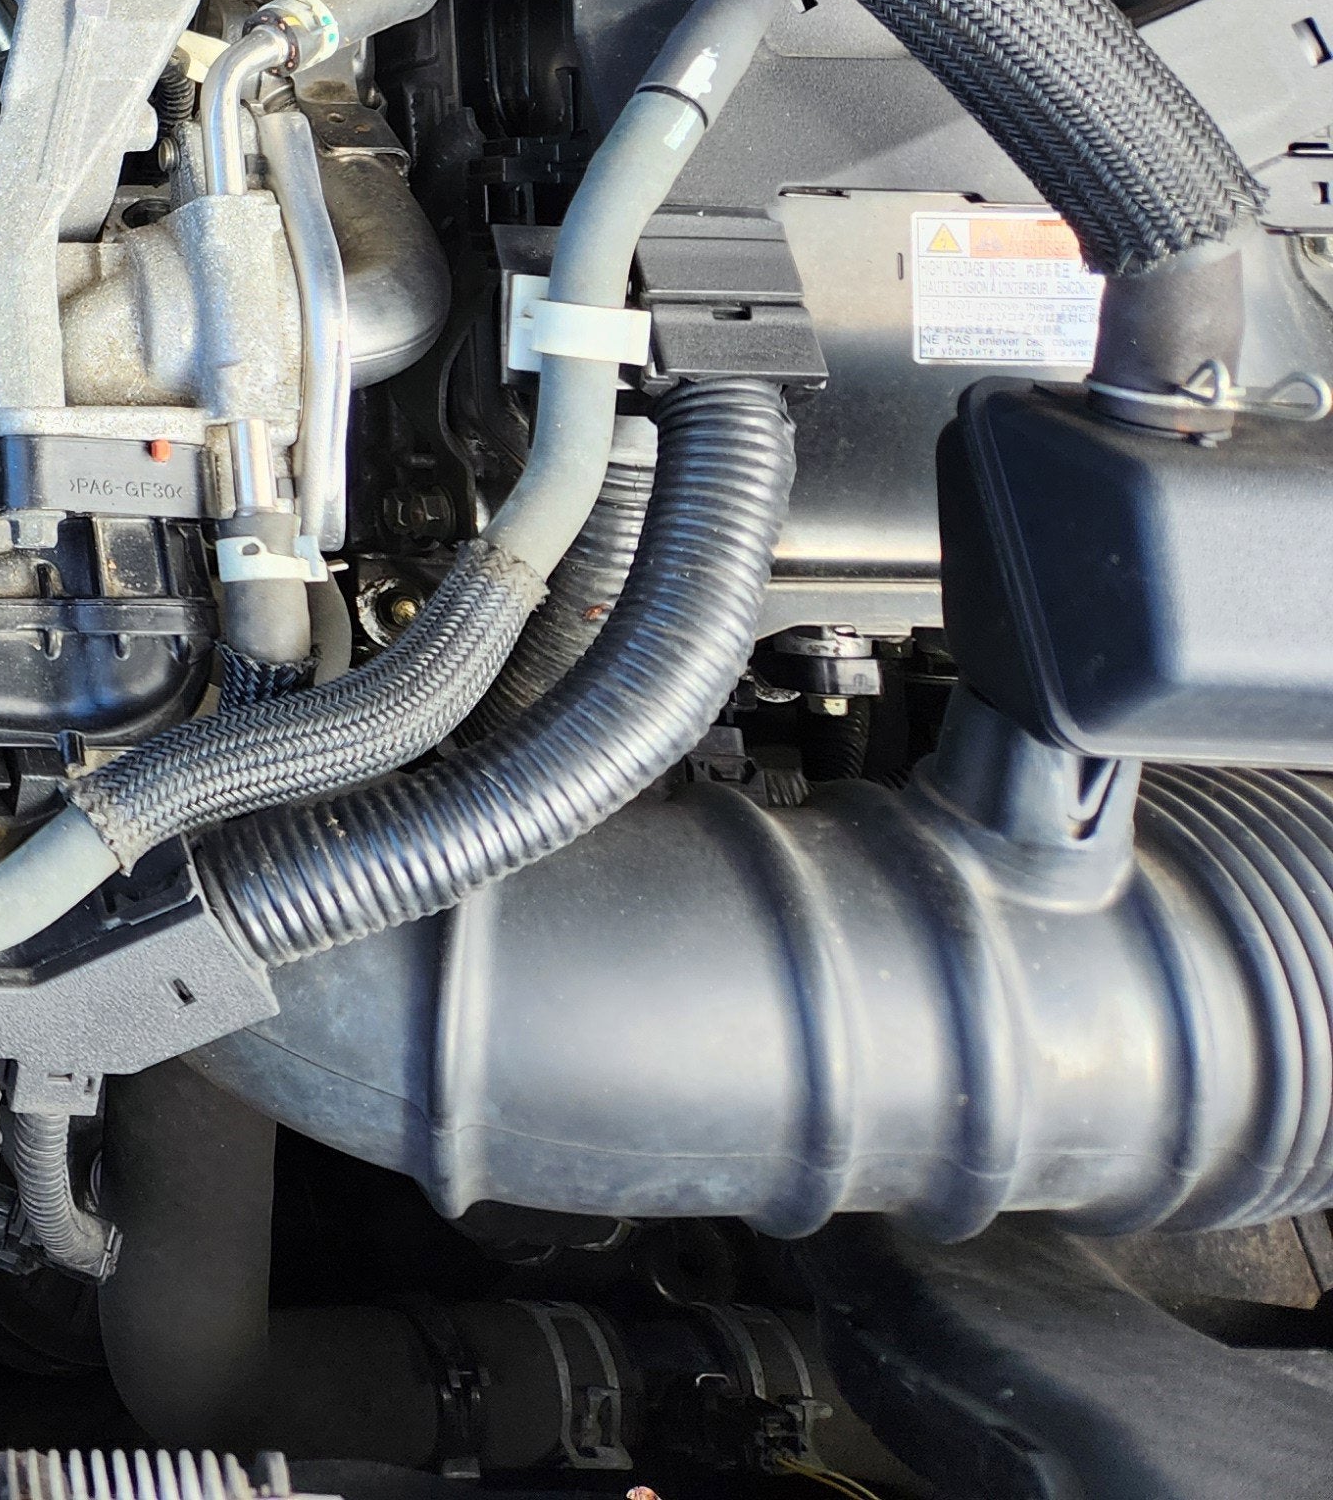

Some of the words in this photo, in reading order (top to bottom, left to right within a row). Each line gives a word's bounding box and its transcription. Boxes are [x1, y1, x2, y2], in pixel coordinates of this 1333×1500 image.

[922, 334, 940, 345] NE
[947, 334, 972, 346] PAS
[69, 477, 183, 500] >PA6-GF30<
